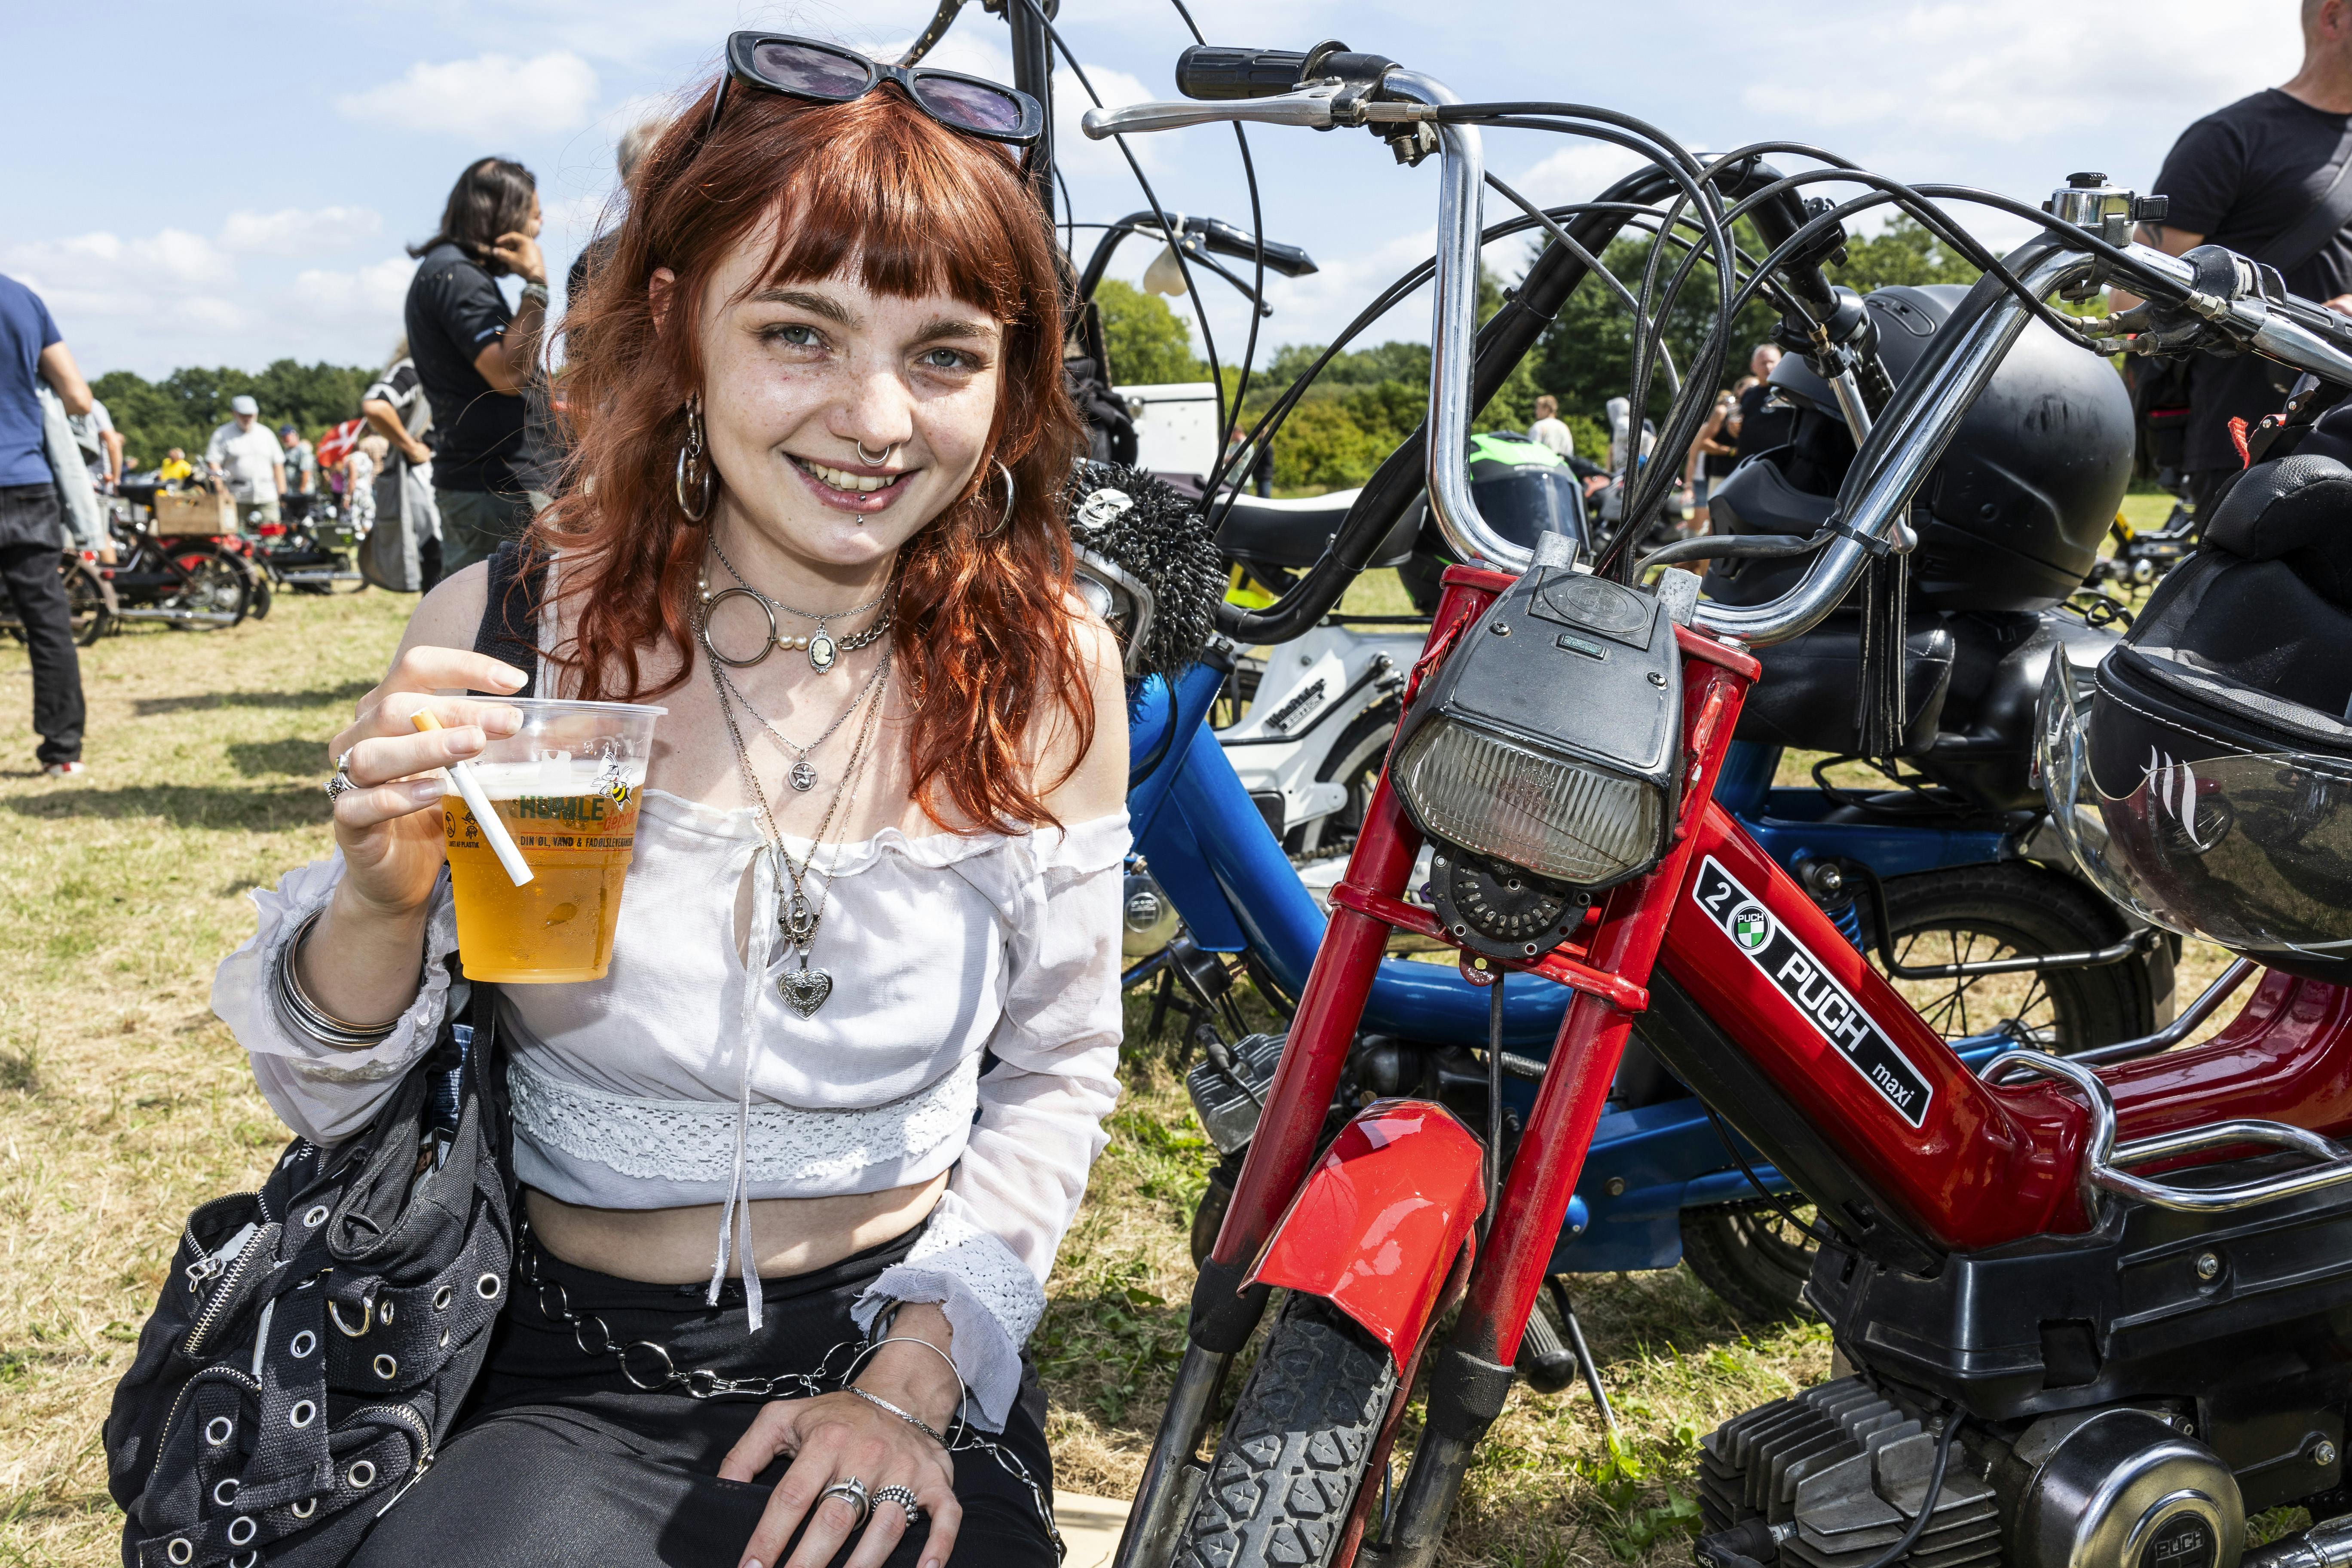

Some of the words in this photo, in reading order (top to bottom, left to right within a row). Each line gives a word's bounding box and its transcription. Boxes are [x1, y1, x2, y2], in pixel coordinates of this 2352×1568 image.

[520, 795, 604, 821] HUMLE
[521, 836, 534, 846] DIN
[538, 836, 551, 848] ØL,
[553, 837, 574, 847] VAND
[577, 838, 582, 847] &
[1705, 882, 1731, 912] 2
[1738, 913, 1764, 923] PUCH
[1777, 951, 1870, 1052] PUCH
[1872, 1063, 1916, 1108] maxi
[2155, 1528, 2204, 1561] PUCH
[1698, 1554, 1714, 1568] NGK
